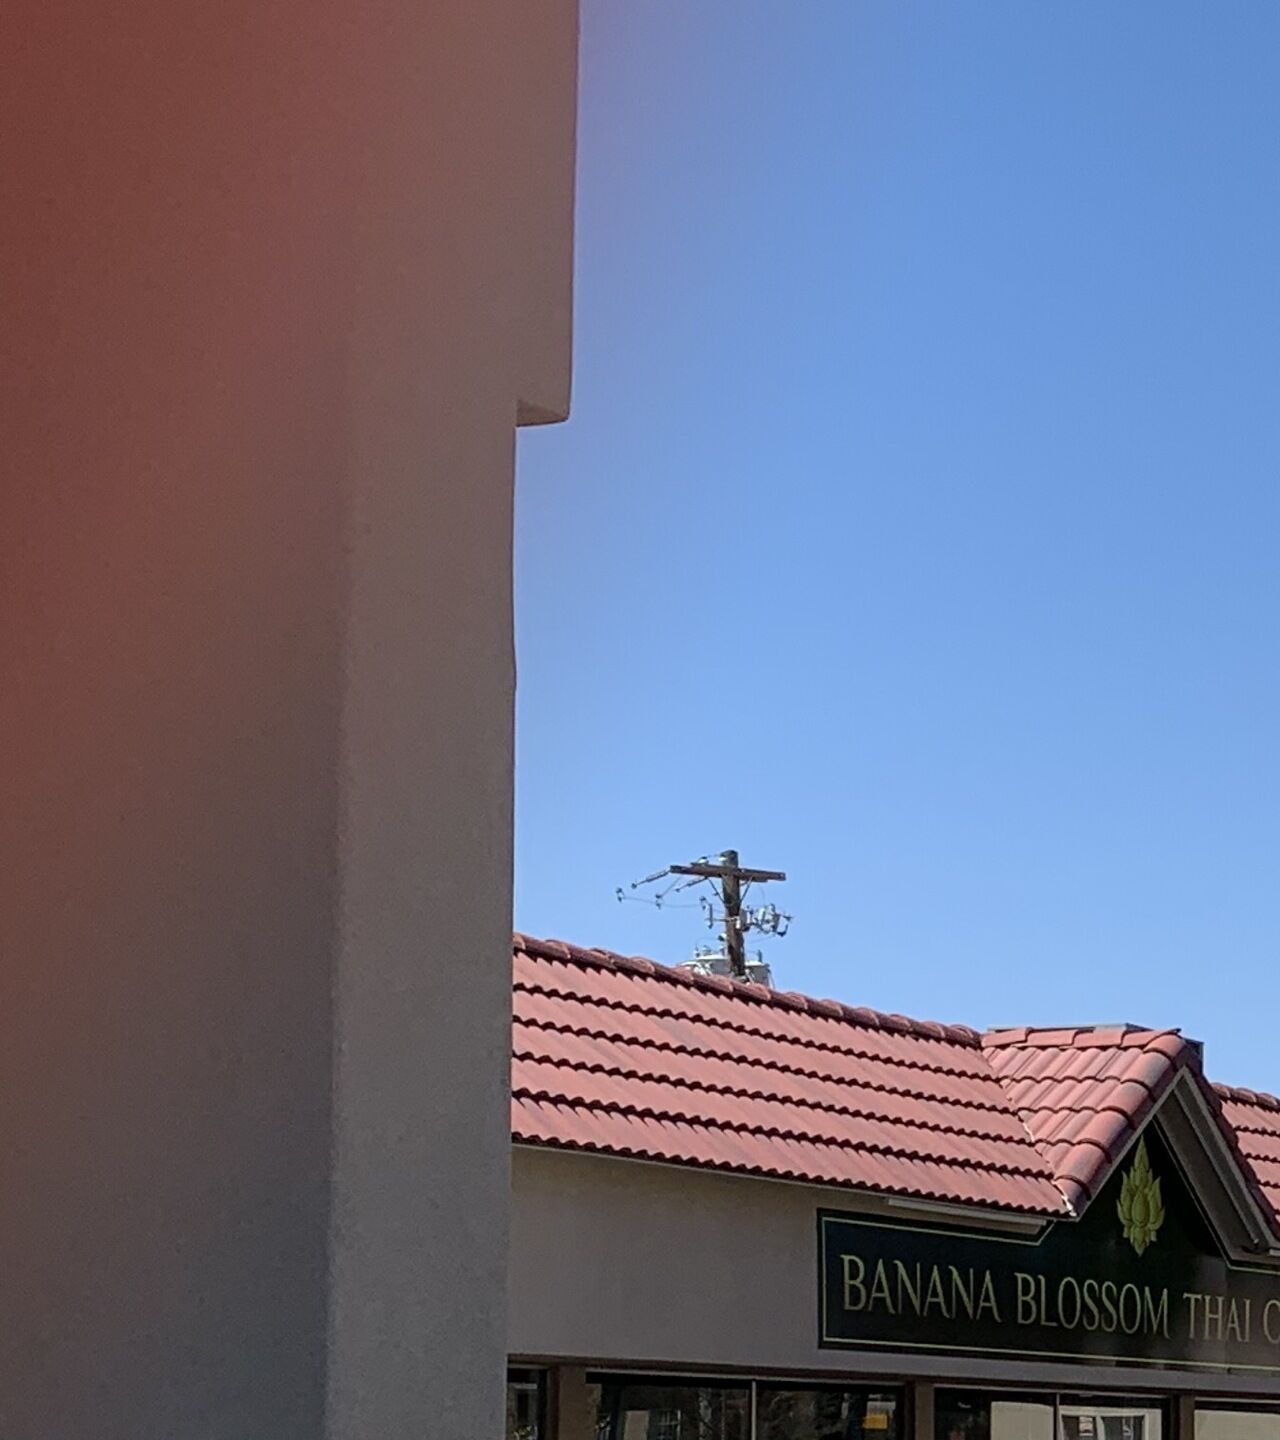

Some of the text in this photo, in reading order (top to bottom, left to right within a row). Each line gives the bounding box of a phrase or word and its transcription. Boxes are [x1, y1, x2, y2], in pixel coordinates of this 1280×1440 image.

[840, 1254, 1002, 1323] BANANA
[1014, 1272, 1171, 1340] BLOSSOM
[1183, 1292, 1250, 1343] THAI
